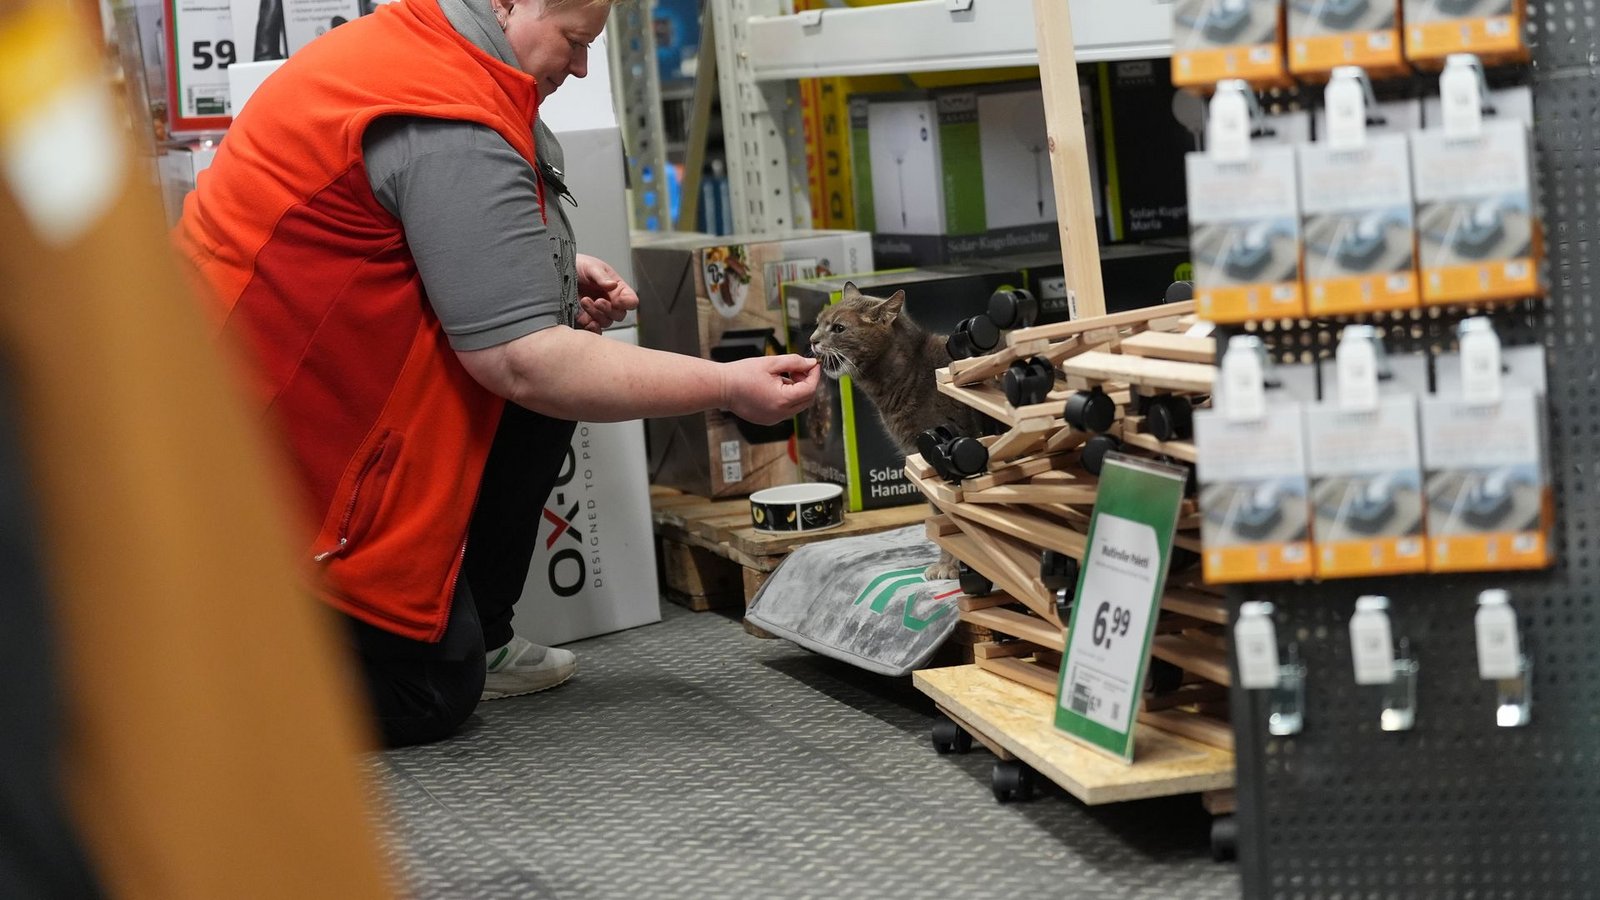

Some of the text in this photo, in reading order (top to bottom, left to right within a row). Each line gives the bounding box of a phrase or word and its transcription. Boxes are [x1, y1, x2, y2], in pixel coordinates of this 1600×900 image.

[193, 39, 236, 70] 59
[580, 421, 603, 588] DESIGNED TO PRO
[1092, 601, 1131, 650] 6.99
